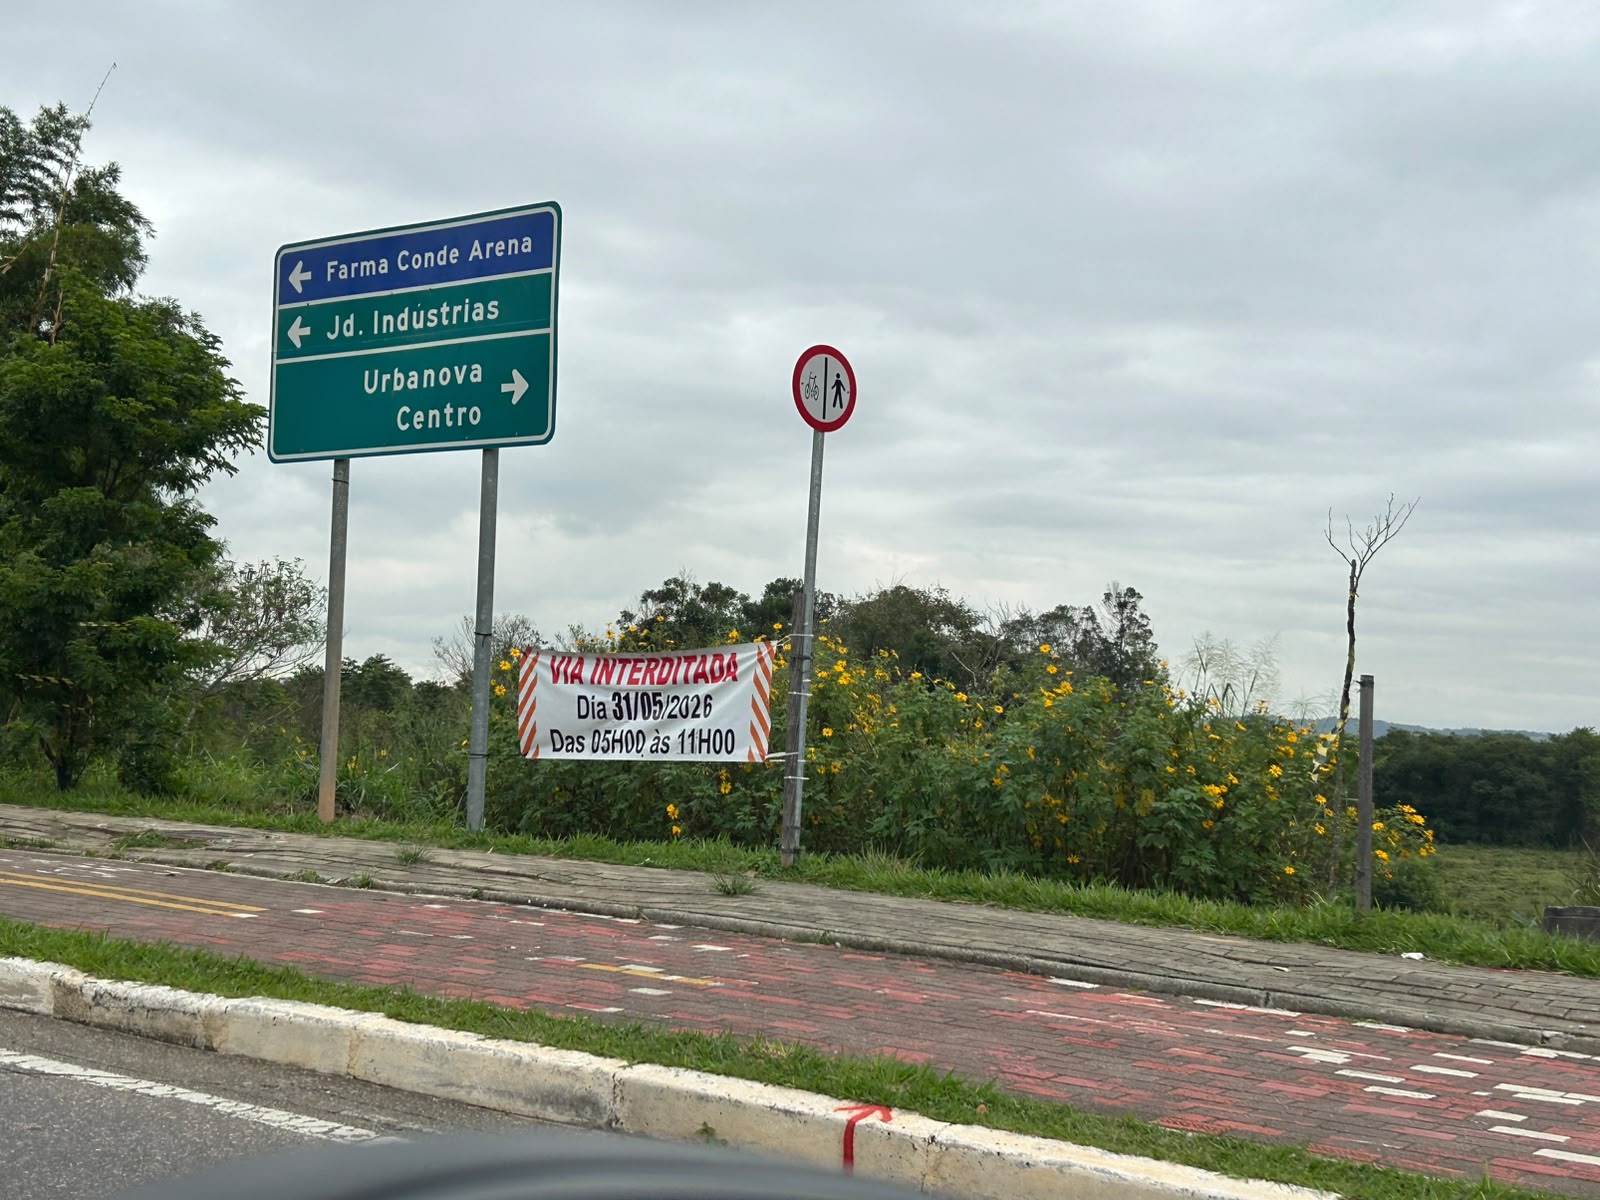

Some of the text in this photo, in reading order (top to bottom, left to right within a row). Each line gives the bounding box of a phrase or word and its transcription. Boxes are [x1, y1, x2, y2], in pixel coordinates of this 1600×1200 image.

[326, 236, 532, 282] Farma Conde Arena
[326, 298, 500, 340] Jd. Indústrias
[363, 363, 482, 394] Urbanova
[396, 402, 482, 431] Centro
[550, 652, 738, 686] VIA INTERDITADA
[577, 691, 713, 720] Dia 31/05/2026
[550, 728, 735, 755] Das 05H00 às 11H00
